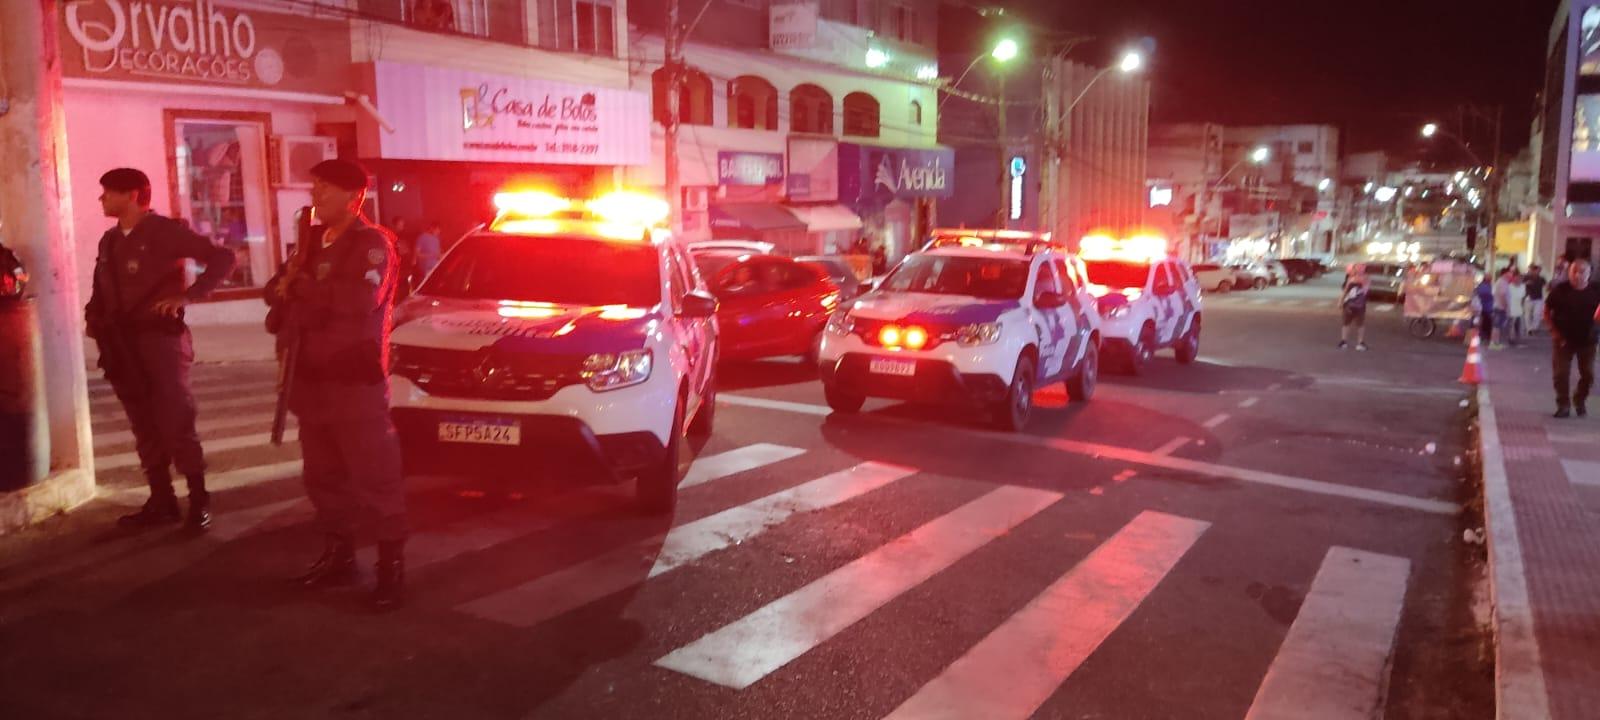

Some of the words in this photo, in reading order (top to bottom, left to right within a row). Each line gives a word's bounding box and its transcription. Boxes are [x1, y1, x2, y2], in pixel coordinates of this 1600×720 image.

[65, 0, 255, 58] Orvalho
[491, 88, 533, 117] Casa
[537, 94, 557, 119] de
[897, 156, 945, 191] Avenida
